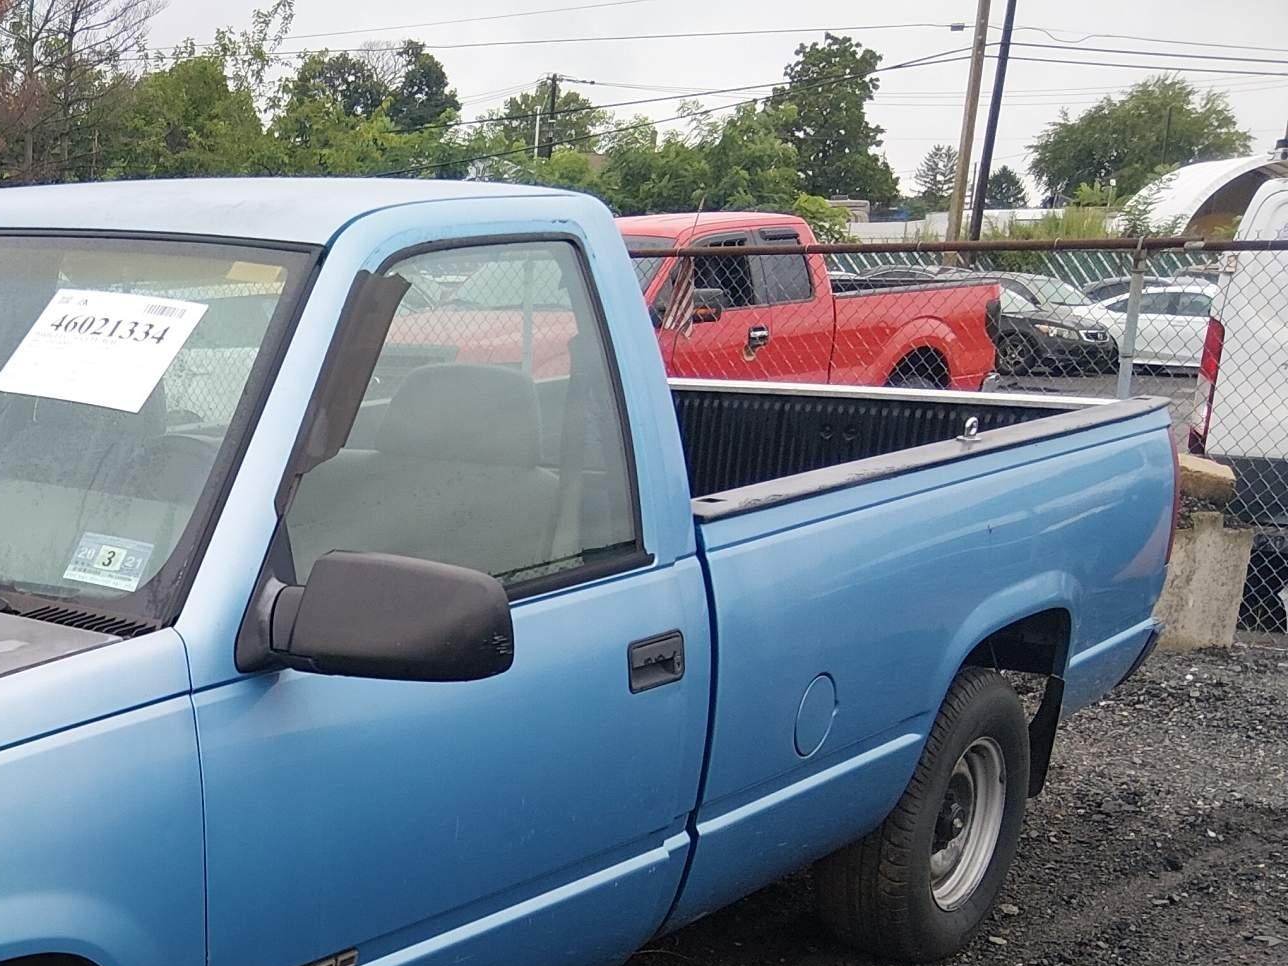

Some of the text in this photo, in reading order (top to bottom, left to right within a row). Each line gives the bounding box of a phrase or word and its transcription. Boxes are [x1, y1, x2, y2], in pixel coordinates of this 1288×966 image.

[49, 313, 171, 345] 46021334
[77, 547, 144, 569] 20 3 21
